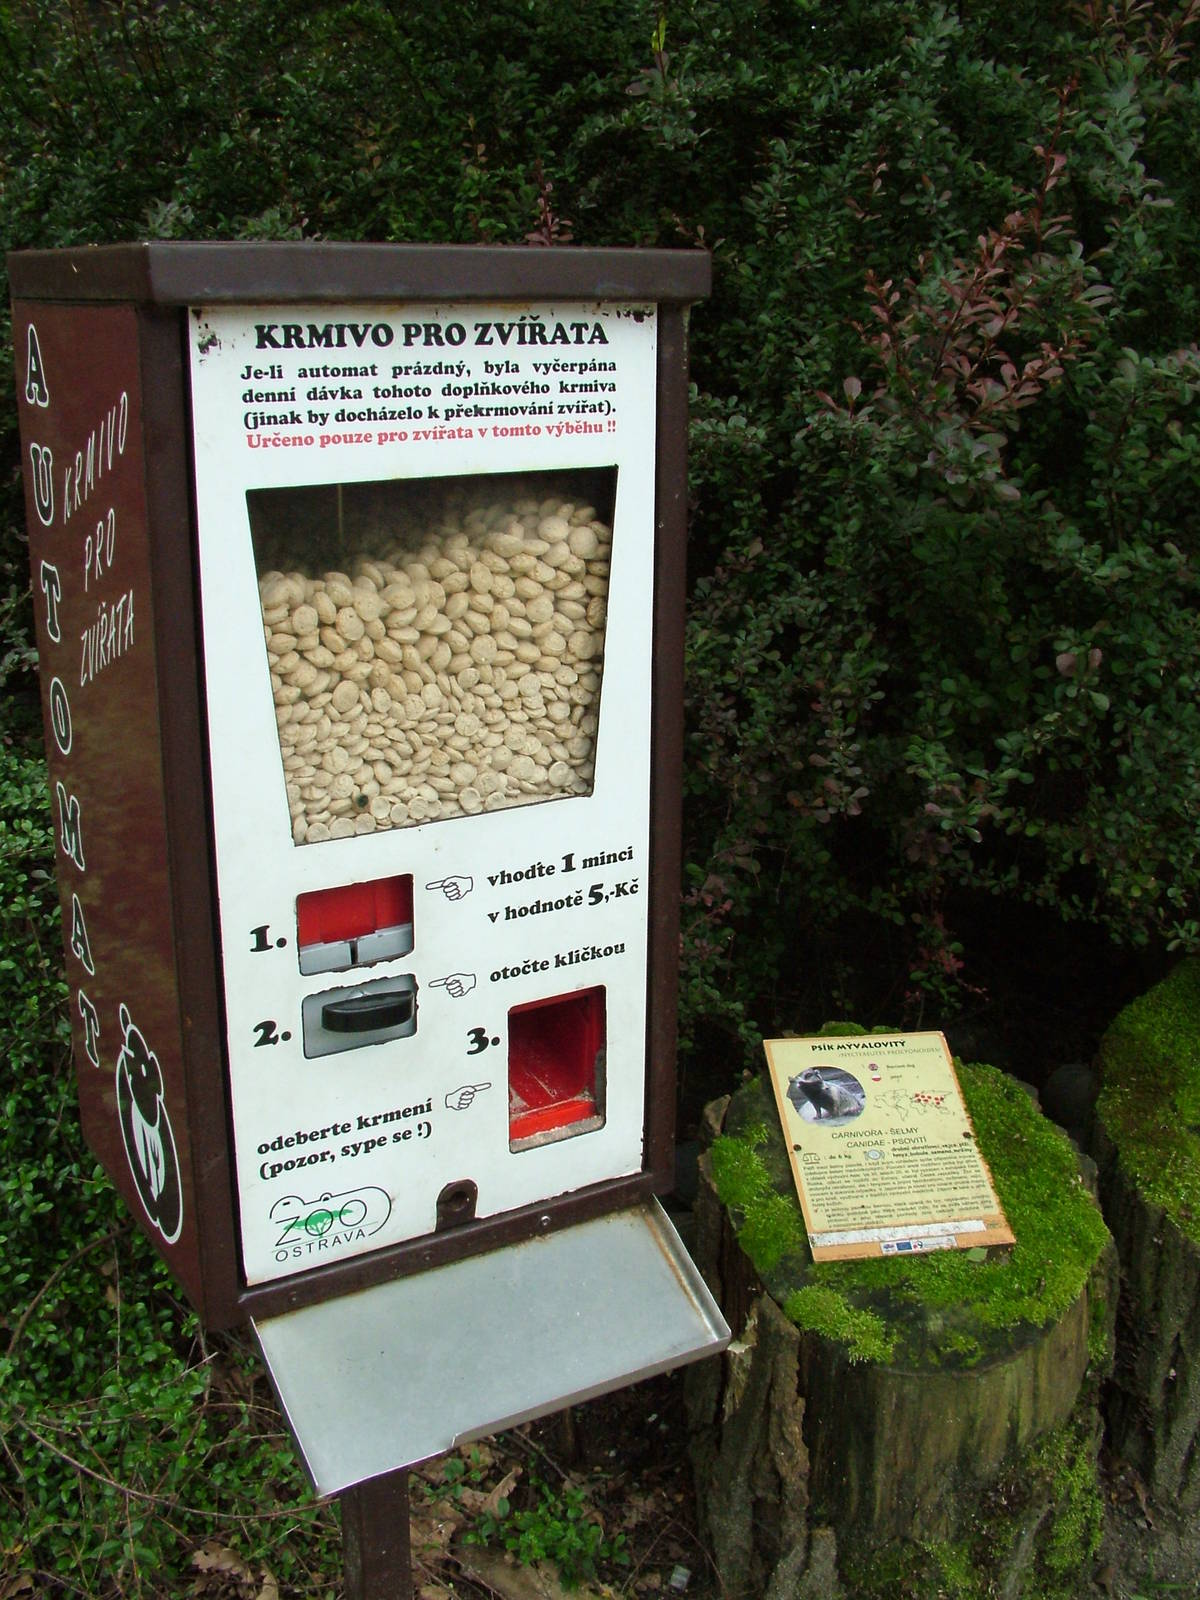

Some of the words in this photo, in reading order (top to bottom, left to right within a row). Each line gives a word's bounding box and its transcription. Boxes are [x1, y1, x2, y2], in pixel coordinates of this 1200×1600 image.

[254, 322, 395, 350] KRMIVO
[401, 322, 467, 348] PRO
[474, 314, 609, 347] ZVÍŘATA
[240, 365, 284, 380] Je-li
[297, 363, 379, 378] automat
[391, 361, 471, 379] prázdný,
[483, 360, 520, 377] byla
[531, 358, 617, 375] vyčerpána
[241, 387, 297, 403] denní
[306, 386, 363, 401] dávka
[373, 384, 432, 399] tohoto
[441, 380, 551, 399] doplňkového
[559, 380, 617, 394] krmiva
[243, 410, 303, 430] (jinak
[307, 409, 330, 426] by
[334, 406, 423, 423] docházelo
[427, 405, 440, 419] k
[444, 401, 554, 421] překrmování
[557, 399, 617, 416] zvířat).
[246, 431, 315, 449] Určeno
[319, 432, 373, 448] pouze
[377, 430, 409, 445] pro
[412, 425, 473, 442] zvířata
[478, 426, 488, 438] v
[492, 422, 542, 438] tomto
[545, 419, 603, 438] výběhu
[84, 508, 116, 592] PRO
[560, 852, 577, 873] 1
[581, 845, 635, 870] minci
[486, 911, 500, 924] v
[504, 889, 584, 921] hodnotě
[249, 924, 287, 953] 1.
[489, 959, 550, 983] otočte
[252, 1020, 292, 1048] 2.
[466, 1027, 501, 1056] 3.
[811, 1043, 834, 1052] PSÍK
[256, 1121, 352, 1156] odeberte
[357, 1097, 433, 1131] krmení
[831, 1129, 883, 1140] CARNIVORA
[889, 1126, 919, 1136] ŠELMY
[259, 1149, 337, 1181] (pozor,
[340, 1134, 388, 1158] sype
[392, 1129, 413, 1144] se
[846, 1140, 886, 1149] CANIDAE
[275, 1199, 368, 1247] ZOO
[275, 1227, 366, 1263] OSTRAVA
